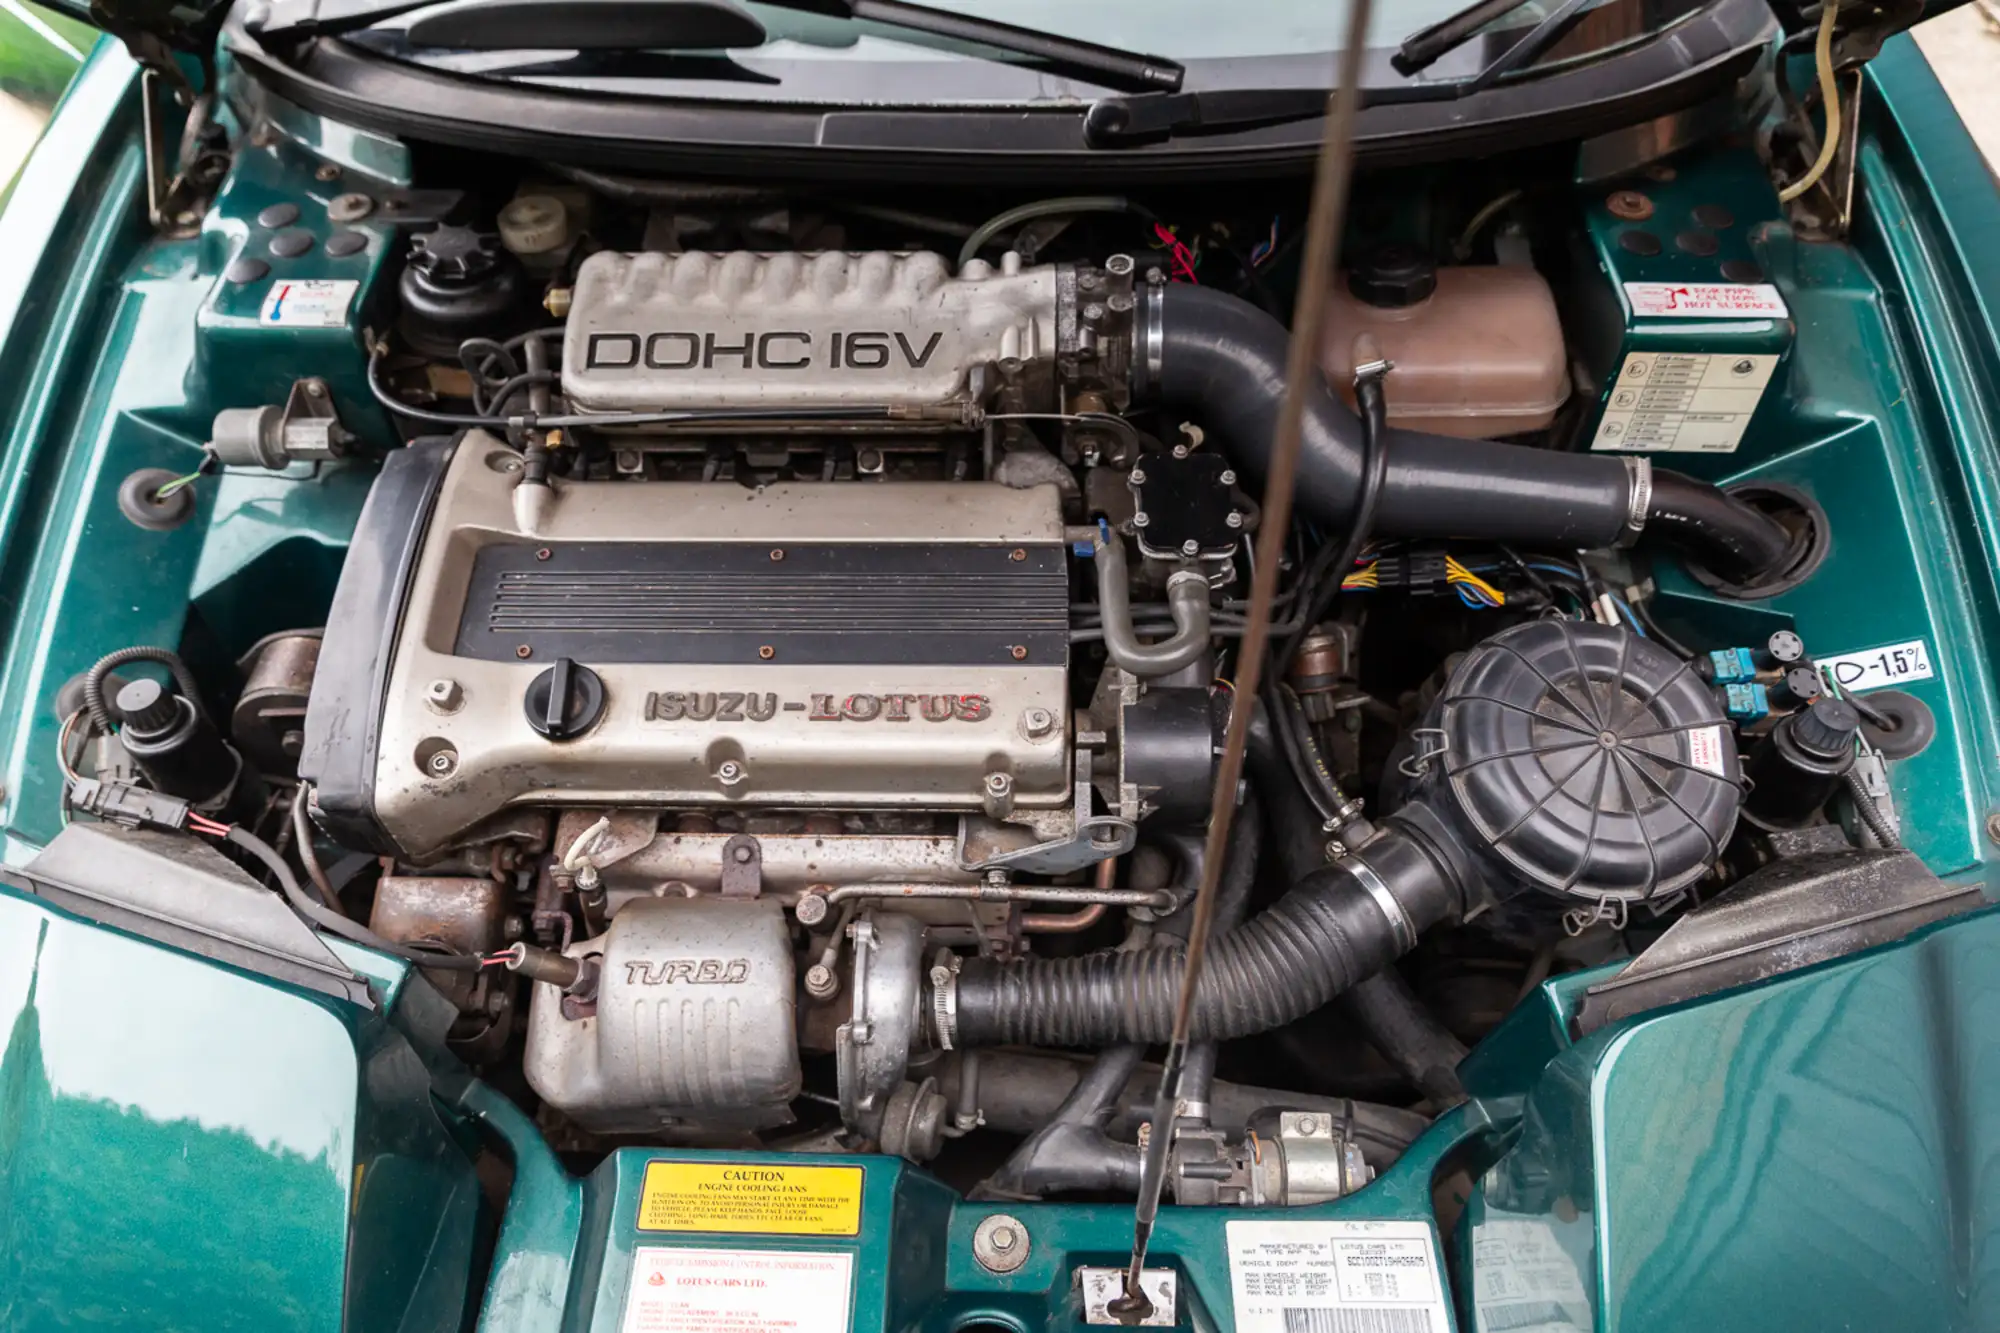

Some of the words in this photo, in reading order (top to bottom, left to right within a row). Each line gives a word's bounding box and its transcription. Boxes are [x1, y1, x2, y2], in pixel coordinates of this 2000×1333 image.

[1684, 301, 1711, 309] HOT
[1717, 302, 1776, 310] SURFACE
[585, 332, 811, 370] DOHC
[829, 332, 944, 370] 16V
[645, 691, 992, 723] ISUZU-LOTUS
[625, 958, 750, 985] TURBO
[722, 1170, 785, 1181] CAUTION
[698, 1183, 734, 1191] ENGINE
[736, 1184, 780, 1192] COOLING
[782, 1185, 808, 1193] FANS
[774, 1261, 835, 1270] INFORMATION
[677, 1277, 712, 1287] LOTUS
[714, 1278, 741, 1287] CARS
[744, 1278, 767, 1288] LTD.
